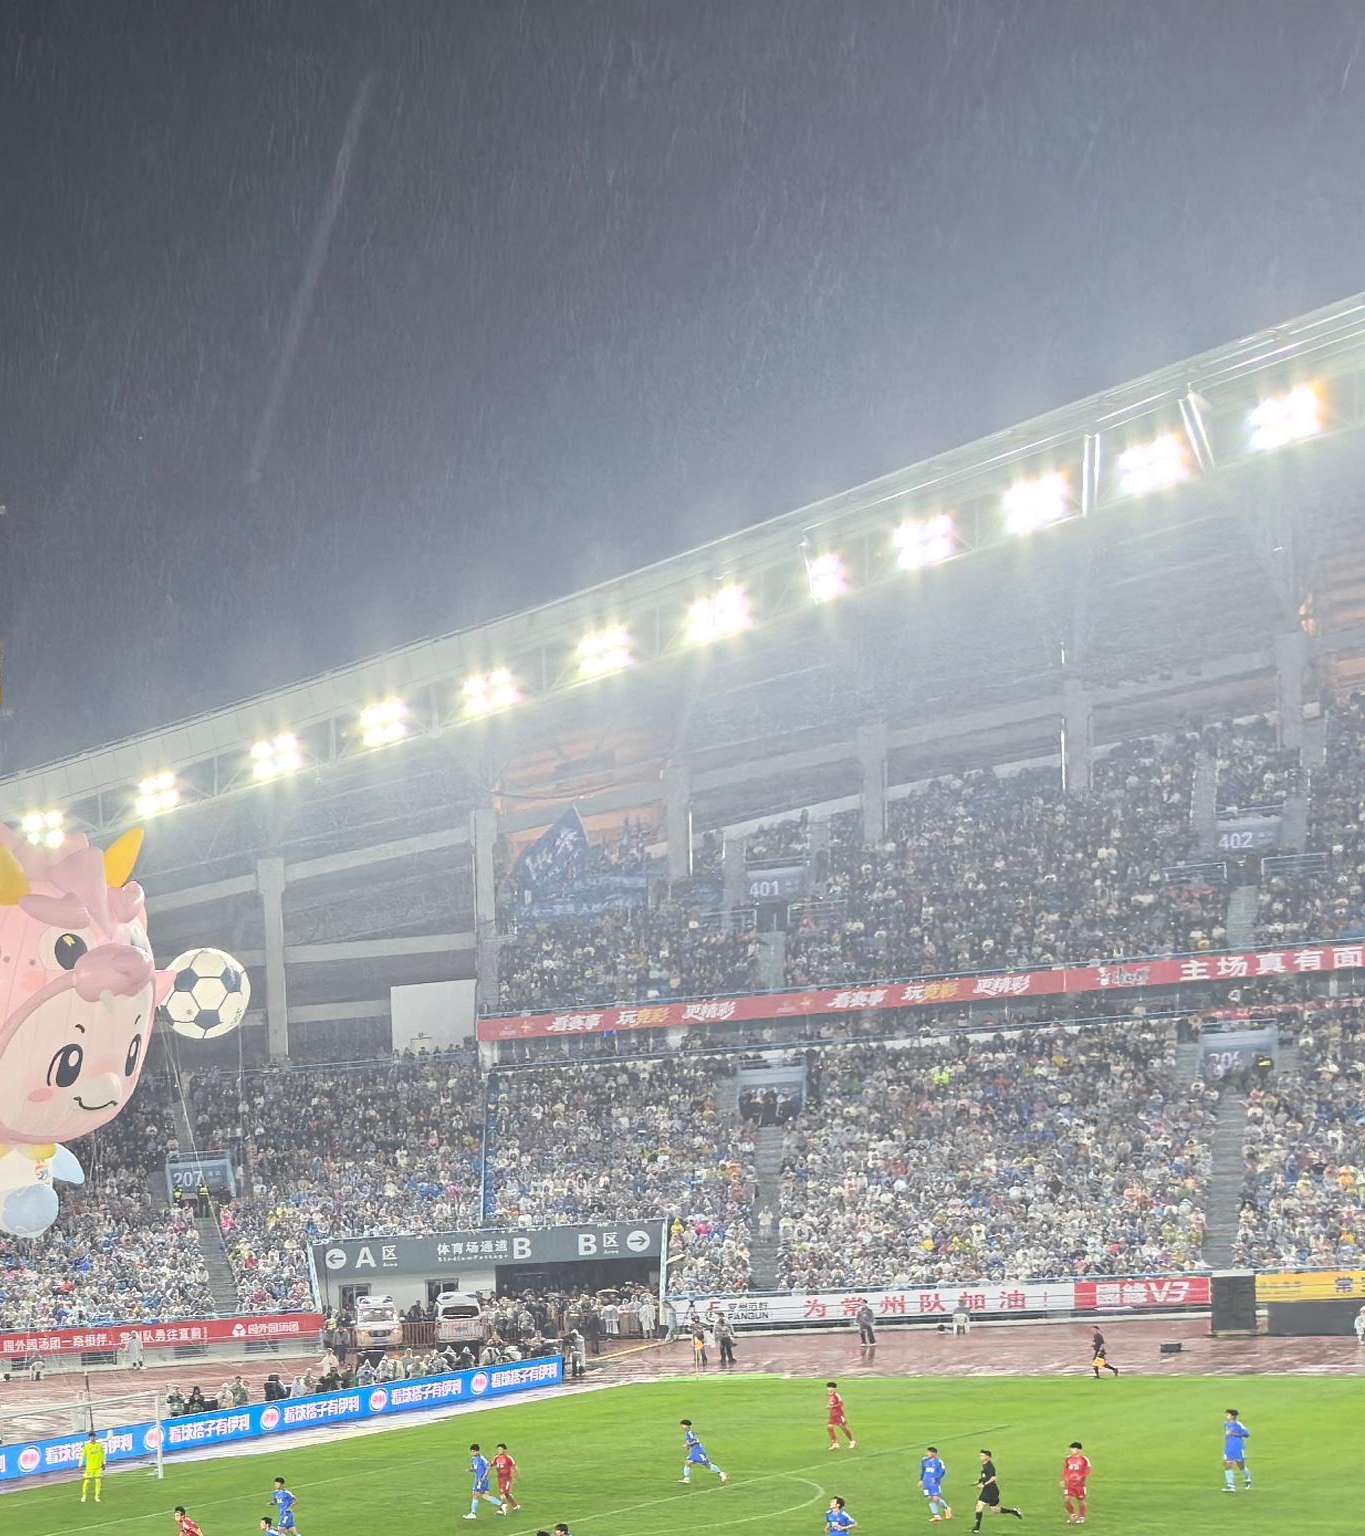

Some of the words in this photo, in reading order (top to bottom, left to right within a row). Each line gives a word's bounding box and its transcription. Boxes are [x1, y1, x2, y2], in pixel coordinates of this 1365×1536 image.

[1218, 832, 1254, 850] 402
[749, 880, 779, 898] 401
[437, 1239, 508, 1256] 体育场通道
[513, 1237, 532, 1260] B
[578, 1233, 598, 1256] B
[602, 1231, 619, 1247] 区
[355, 1246, 377, 1269] A
[381, 1244, 398, 1261] 区
[168, 1412, 251, 1444] 看球搭子有伊利
